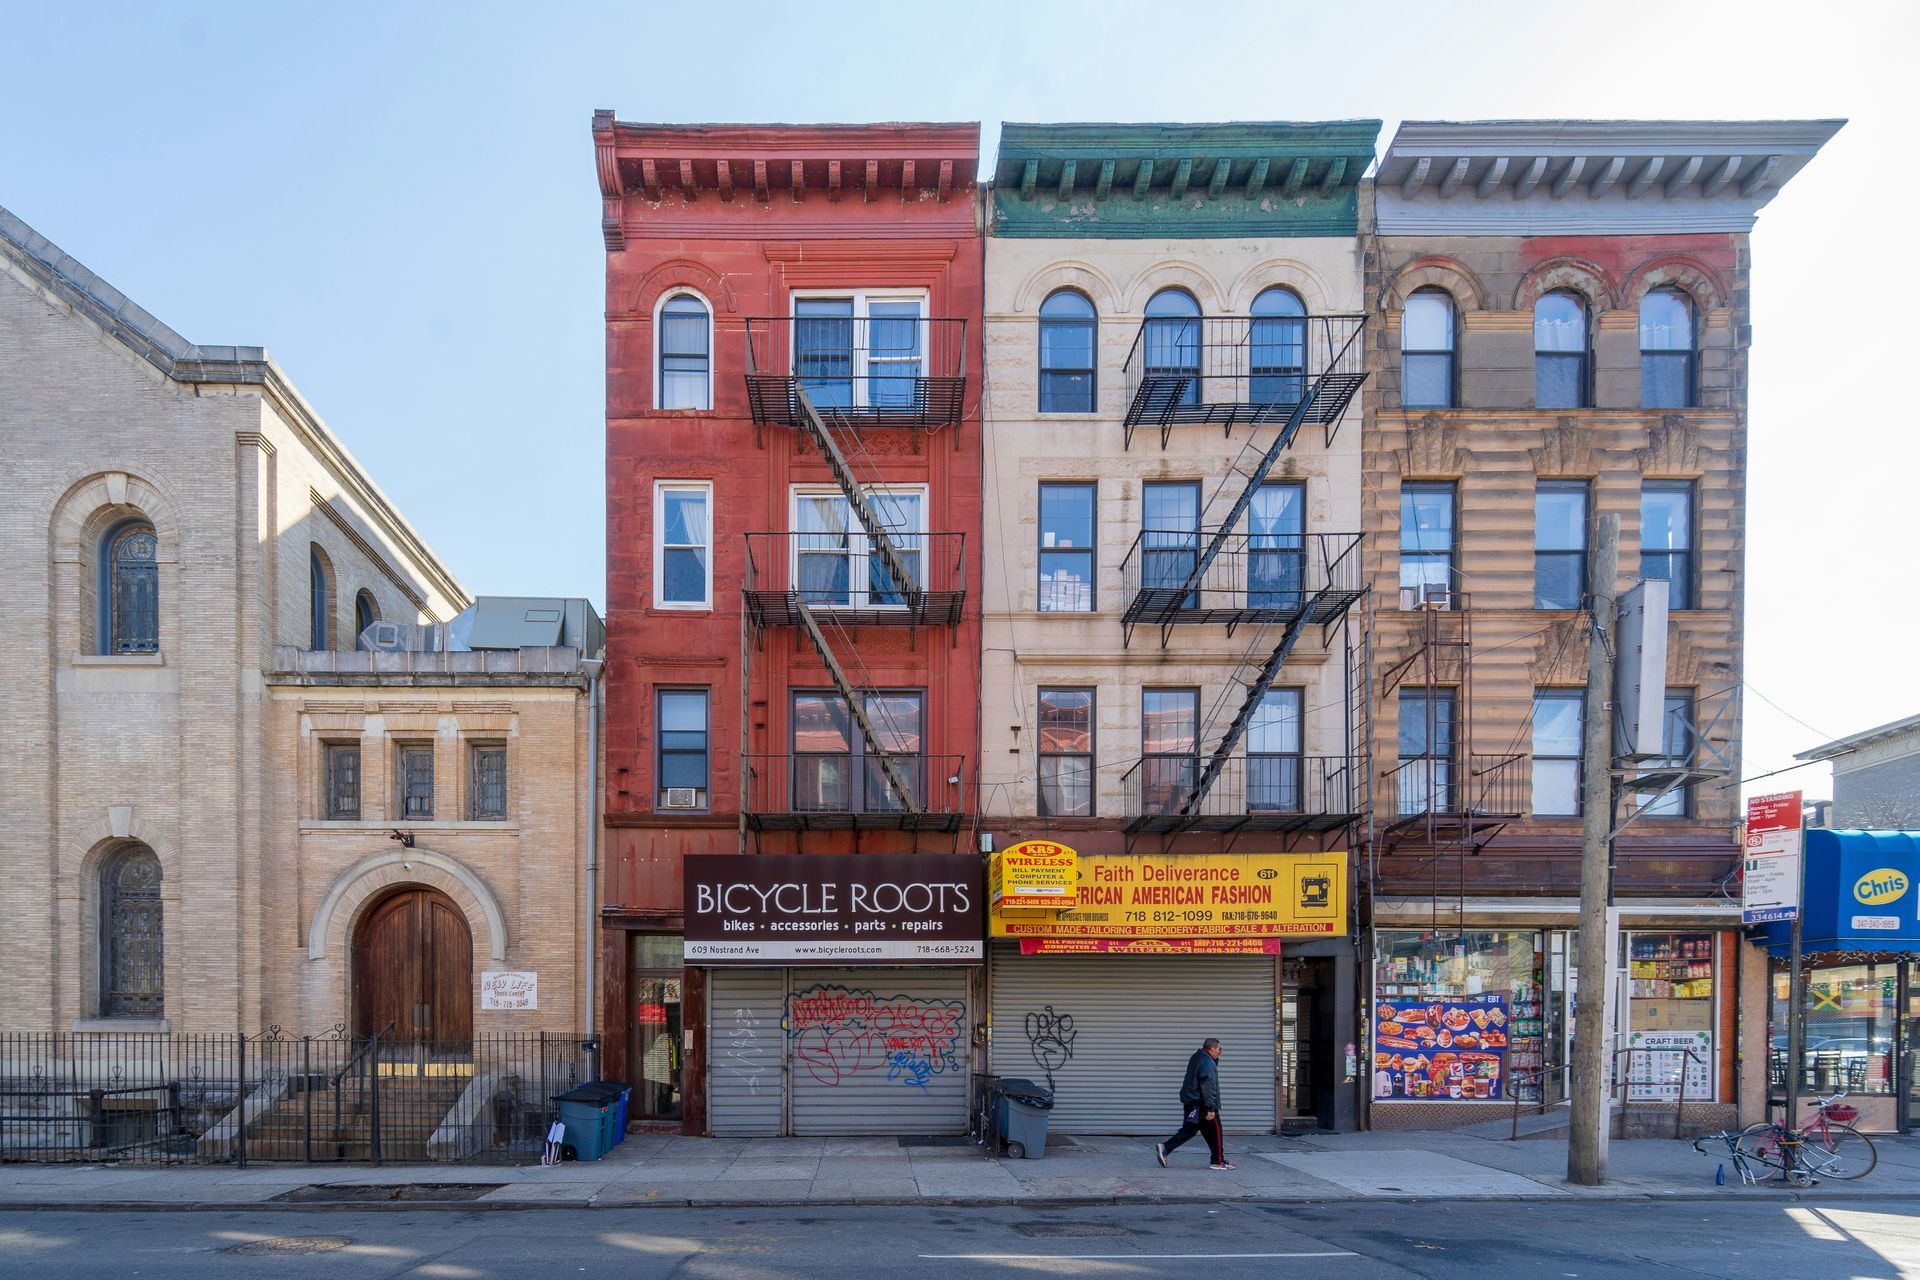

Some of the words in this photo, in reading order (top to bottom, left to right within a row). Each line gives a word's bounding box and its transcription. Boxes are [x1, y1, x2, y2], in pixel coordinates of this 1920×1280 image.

[1761, 794, 1794, 802] STANDING
[1007, 858, 1073, 866] WIRELESS
[1094, 865, 1134, 881] Faith
[1143, 864, 1239, 881] Deliverance
[1260, 870, 1275, 878] 611
[1858, 876, 1904, 899] Chris
[697, 884, 838, 913] BICYCLE
[851, 884, 970, 913] ROOTS
[1077, 886, 1122, 904] RICAN
[1132, 886, 1204, 904] AMERICAN
[1212, 885, 1271, 904] FASHION
[1125, 911, 1146, 921] 718
[1153, 911, 1212, 921] 812-1099
[1751, 912, 1782, 921] 334614
[724, 920, 755, 931] bikes
[770, 920, 839, 931] accessories
[854, 919, 886, 933] parts
[902, 920, 943, 933] repairs
[1234, 925, 1257, 933] SALE
[1262, 924, 1268, 932] &
[1272, 923, 1326, 932] ALTERATION
[795, 946, 882, 955] www.bicycleroots.com
[484, 980, 507, 991] NEW
[510, 980, 535, 991] LIFE
